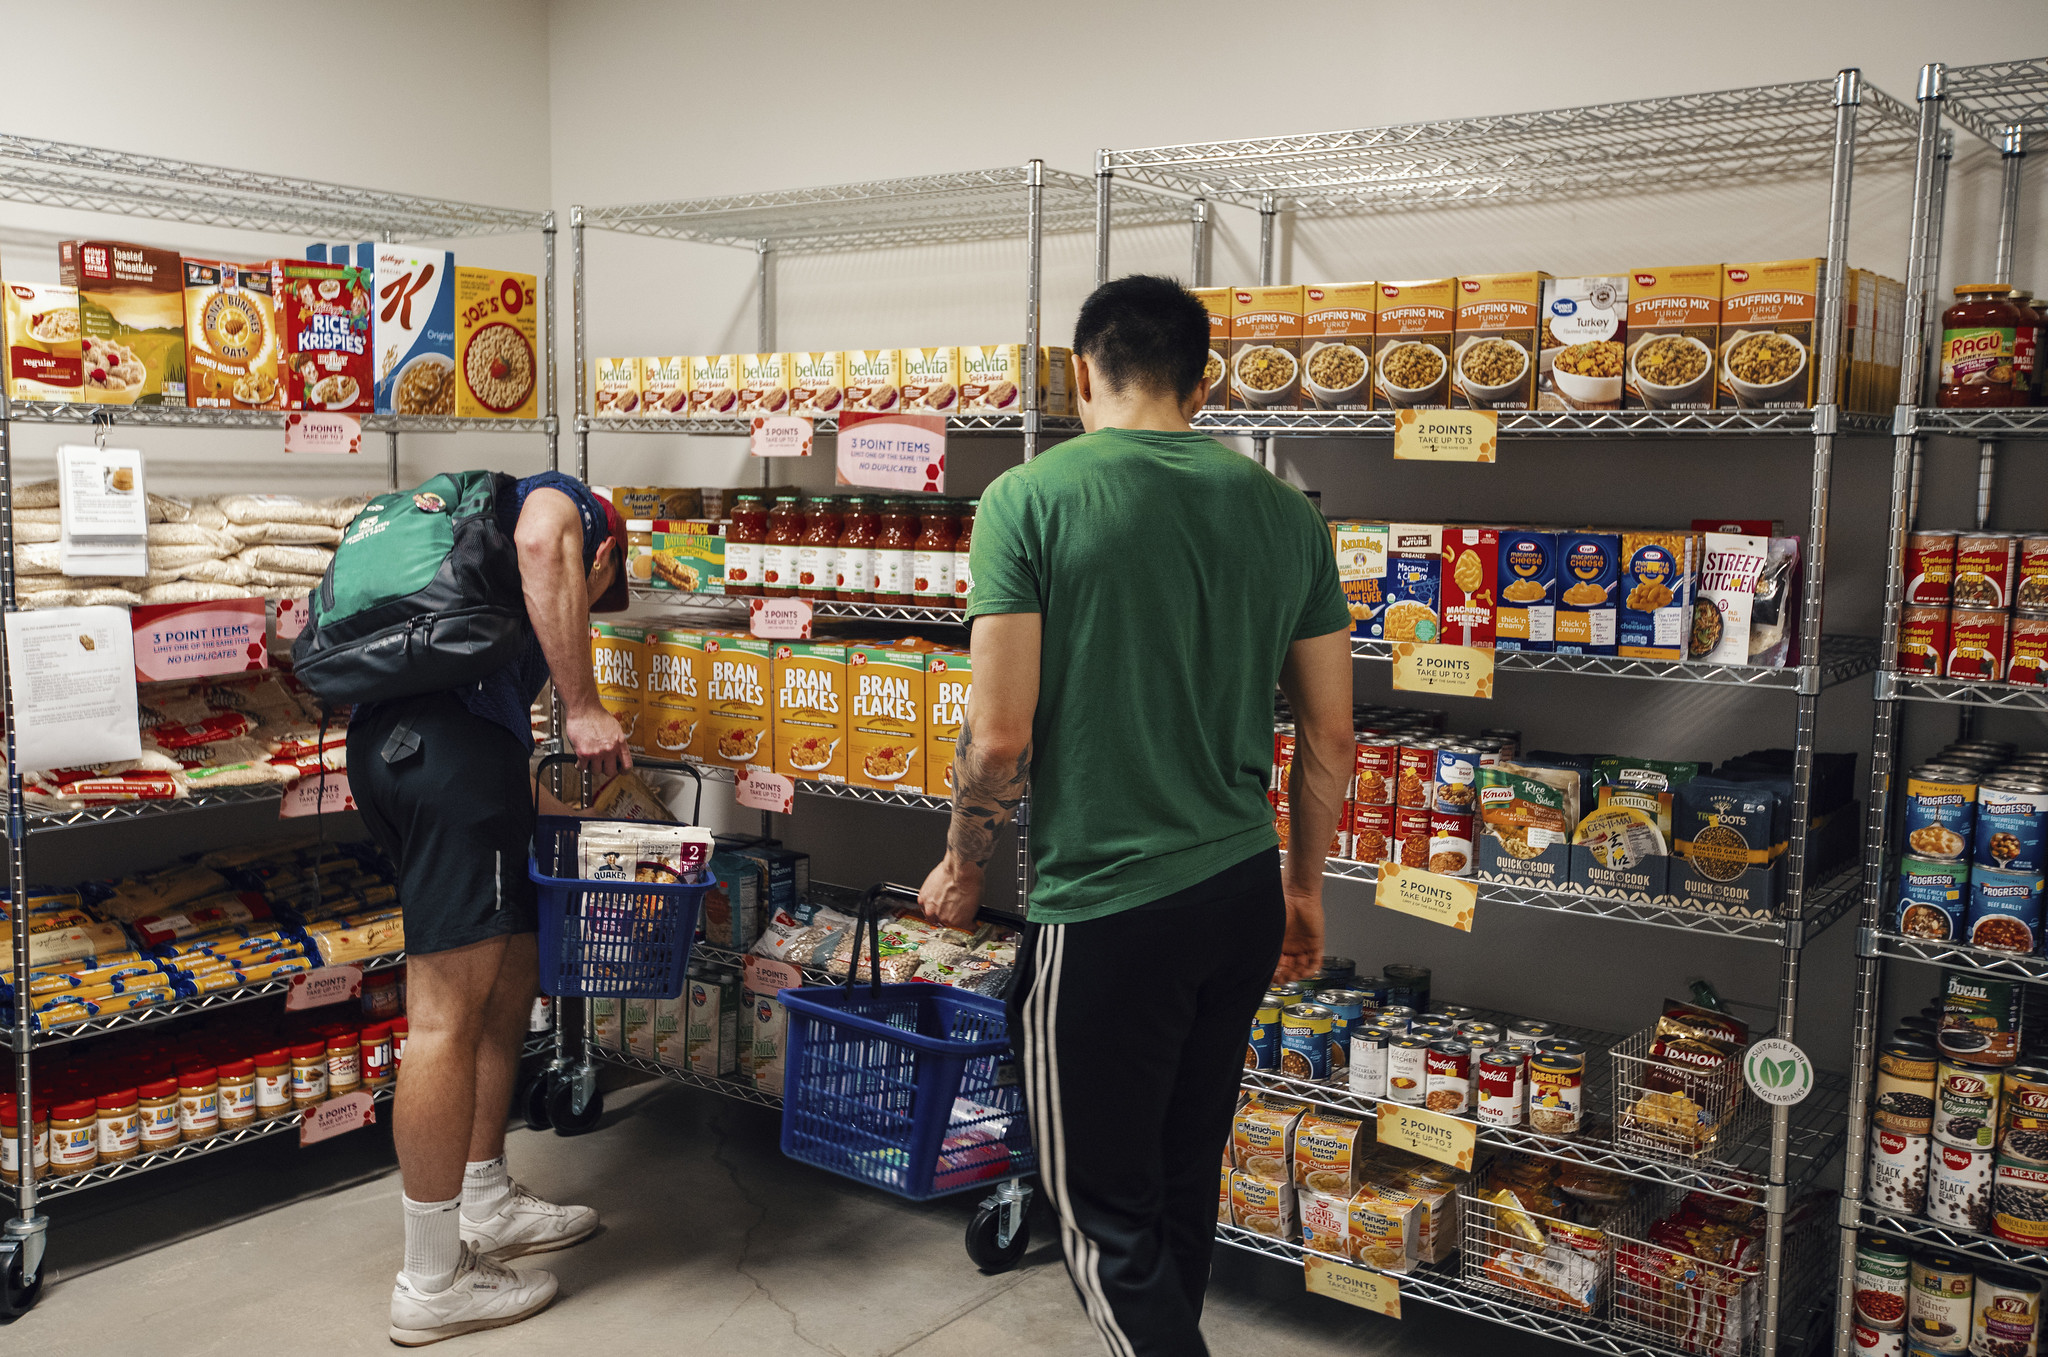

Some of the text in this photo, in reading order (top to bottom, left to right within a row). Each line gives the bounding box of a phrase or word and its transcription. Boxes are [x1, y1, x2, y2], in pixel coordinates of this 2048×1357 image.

[83, 255, 107, 266] BEST
[113, 247, 143, 262] Toasted
[114, 259, 154, 274] Wheatfuls
[380, 263, 435, 330] K
[1727, 293, 1804, 311] STUFFING MIX
[462, 296, 499, 329] JOE'S
[1461, 303, 1528, 318] STUFFING MIX
[1553, 301, 1573, 310] Great
[1746, 305, 1784, 314] TURKEY
[206, 295, 261, 335] HONEY BUNCHES
[1236, 313, 1296, 327] STUFFING MIX
[1477, 314, 1510, 322] TURKEY
[1749, 312, 1779, 323] flavored
[312, 315, 351, 335] RICE
[1576, 317, 1610, 329] Turkey
[427, 329, 454, 342] Original
[298, 331, 364, 356] KRISPIES
[1951, 332, 2000, 359] RAGÚ
[221, 344, 249, 359] OATS
[22, 357, 57, 369] regular
[195, 355, 246, 376] HONEY ROASTED
[849, 360, 890, 377] belVita
[905, 358, 948, 376] belVita
[964, 356, 1008, 374] belVita
[968, 372, 1004, 383] Soft Baked
[1418, 424, 1473, 435] 2 POINTS
[851, 438, 931, 454] 3 POINT ITEMS
[1418, 436, 1439, 444] TAKE
[1467, 437, 1473, 445] 3
[850, 451, 867, 459] LIMIT
[867, 452, 879, 460] ONE
[887, 453, 898, 461] THE
[898, 454, 915, 462] SAME
[915, 455, 930, 463] ITEM
[859, 462, 917, 474] NO DUPLICATES
[628, 493, 661, 503] Maruchan
[631, 503, 653, 511] Instant
[657, 504, 666, 519] 3
[668, 521, 709, 535] VALUE PACK
[1340, 536, 1384, 554] Annie's
[1401, 538, 1428, 547] NATURE
[672, 547, 704, 557] CRUNCHY
[1397, 562, 1429, 573] Macaroni
[1707, 552, 1765, 573] STREET
[1366, 566, 1384, 574] CHEESE
[1347, 591, 1383, 604] THAN EVER
[764, 610, 798, 619] 3 POINTS
[1446, 614, 1490, 625] CHEESE
[1500, 615, 1518, 624] thick
[153, 624, 249, 644] 3 POINT ITEMS
[1497, 623, 1525, 631] creamy
[1620, 622, 1653, 632] cheesiest
[1954, 630, 1990, 640] Condensed
[153, 645, 171, 654] LIMIT
[173, 643, 189, 652] ONE
[215, 639, 233, 647] SAME
[234, 637, 250, 645] ITEM
[1955, 638, 1988, 649] Tomato
[167, 650, 238, 665] NO DUPLICATES
[776, 647, 791, 658] Post
[1956, 647, 1984, 661] Soup
[712, 661, 758, 686] BRAN
[785, 668, 832, 692] BRAN
[707, 680, 764, 706] FLAKES
[779, 687, 839, 714] FLAKES
[1481, 786, 1514, 800] Knorr
[1521, 781, 1546, 796] Rice
[1535, 794, 1555, 807] Sides
[1608, 797, 1662, 811] FARMHOUSE
[1918, 795, 1963, 806] PROGRESSO
[1587, 817, 1633, 833] GEN-JI-MAI
[688, 845, 700, 861] 2
[1692, 844, 1748, 857] ROASTED GARLIC
[1496, 856, 1555, 874] QUICK COOK
[594, 871, 627, 881] QUAKER
[1400, 879, 1453, 901] 2 POINTS
[1400, 890, 1421, 901] TAKE
[1421, 896, 1433, 904] UP
[1434, 899, 1445, 908] TO
[1987, 901, 2023, 911] BEEF BARLEY
[1391, 1054, 1418, 1064] KITCHEN
[1751, 1041, 1805, 1064] SUITABLE FOR
[1753, 1082, 1805, 1103] VEGETARIANS
[1943, 1092, 1988, 1107] BLACK BEANS
[1943, 1099, 1985, 1115] Organic
[1307, 1136, 1349, 1151] Maruchan
[1880, 1135, 1905, 1150] Raley's
[1309, 1145, 1338, 1156] Instant
[1312, 1152, 1335, 1161] Lunch
[1876, 1163, 1901, 1179] BLACK
[1876, 1173, 1893, 1185] BEANS
[1312, 1206, 1335, 1220] CUP
[1305, 1212, 1342, 1233] NOODLES
[1999, 1215, 2029, 1229] FRIJOLES
[1916, 1285, 1951, 1298] ORGANIC
[1916, 1296, 1951, 1314] Kidney
[1917, 1305, 1948, 1322] Beans
